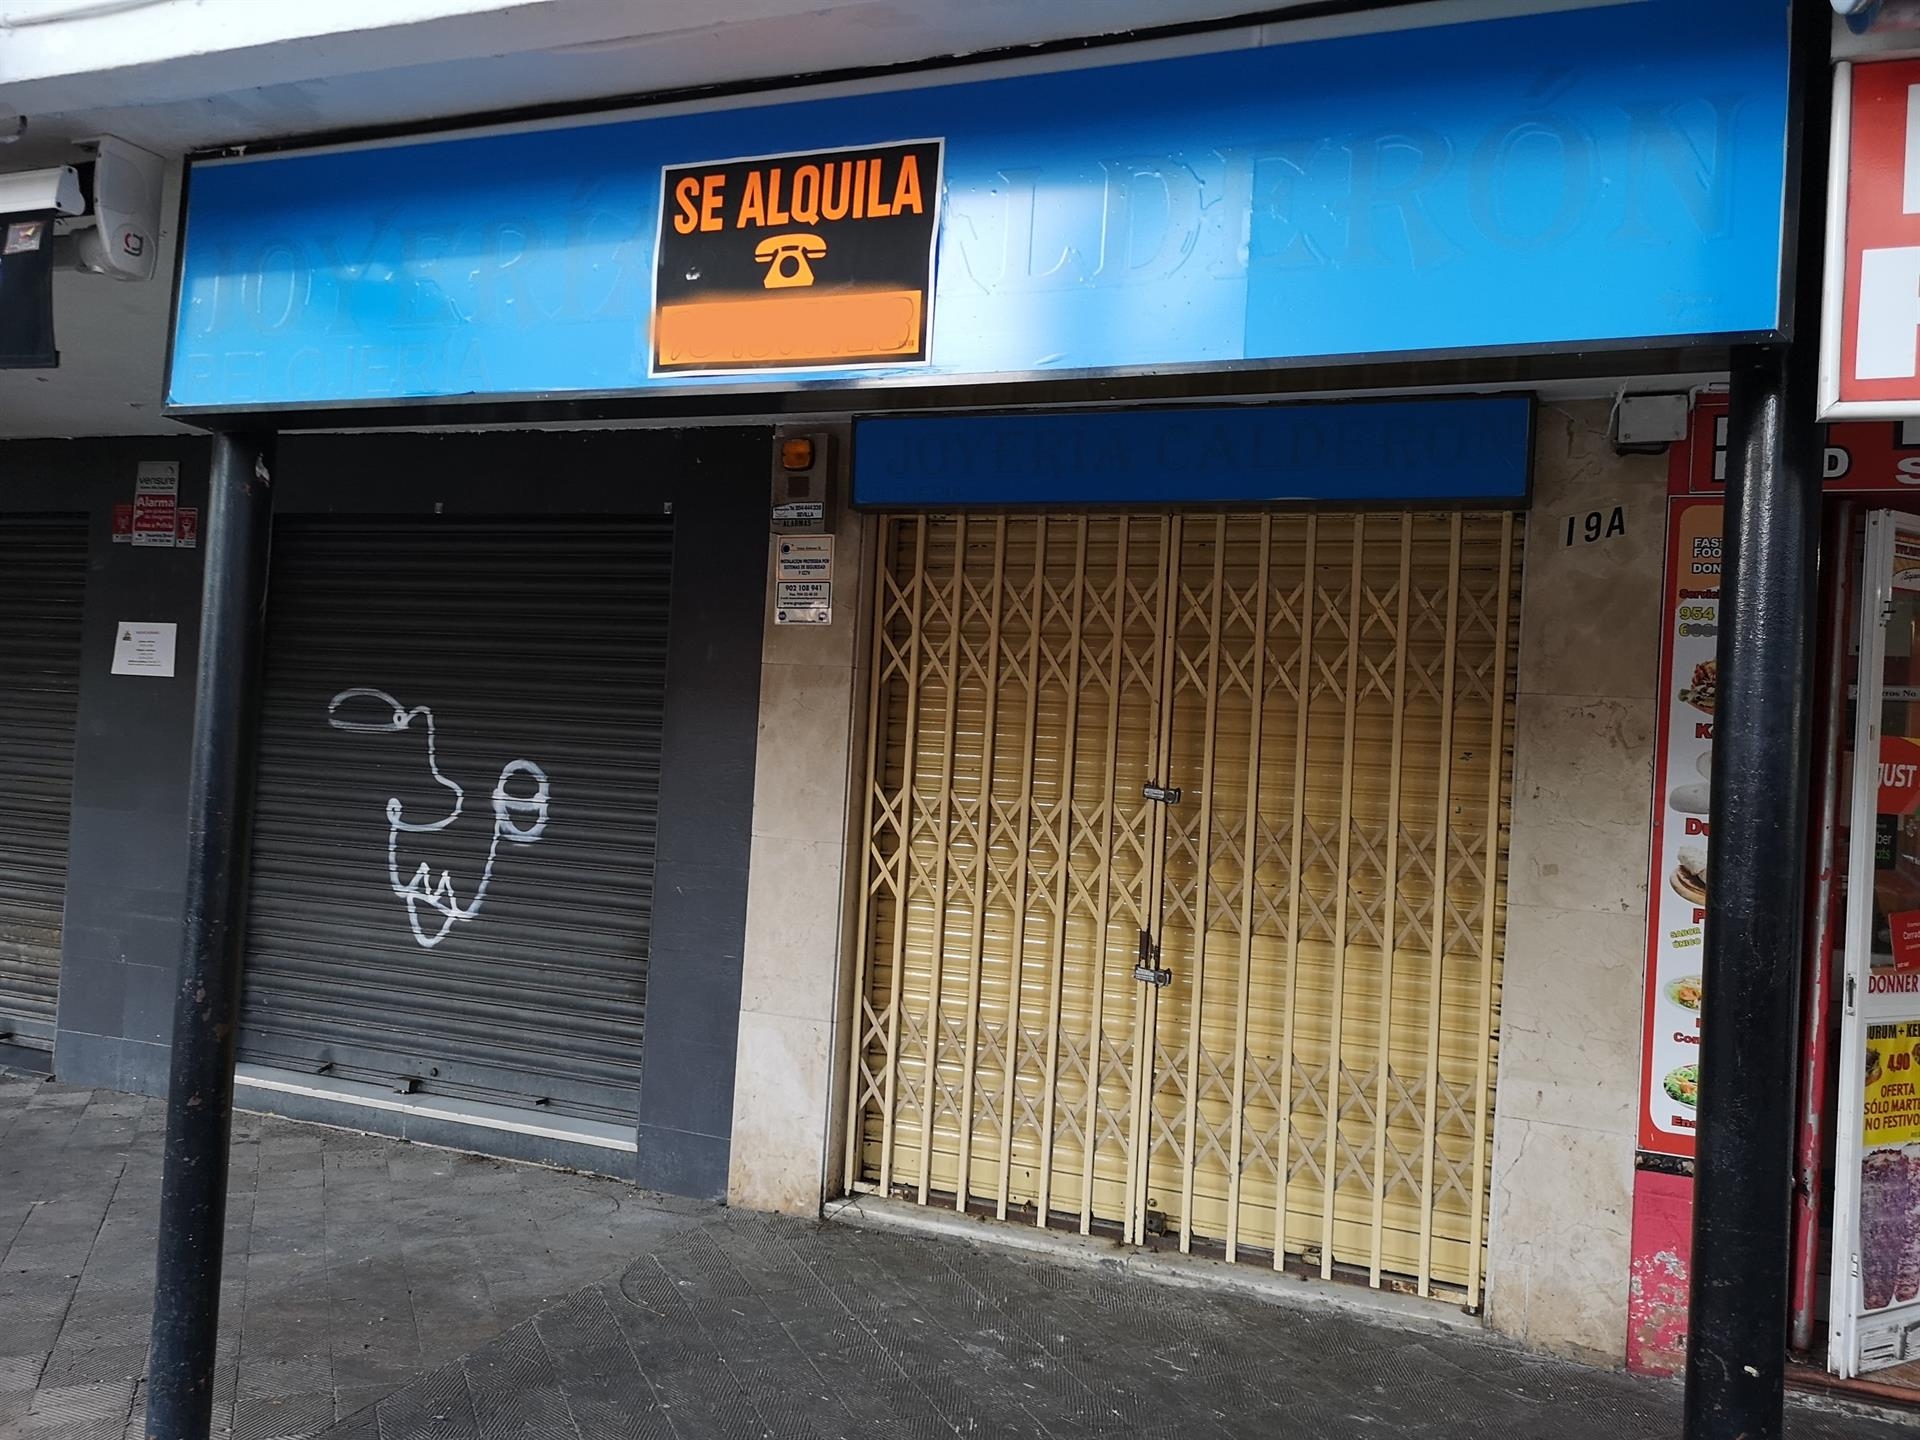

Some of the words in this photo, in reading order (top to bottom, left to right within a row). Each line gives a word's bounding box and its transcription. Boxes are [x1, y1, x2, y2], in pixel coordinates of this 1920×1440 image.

[674, 177, 726, 234] SE
[736, 155, 923, 228] ALQUILA
[136, 496, 174, 507] Alarma
[1567, 506, 1625, 546] 19A
[1679, 606, 1714, 620] 954
[1868, 975, 1919, 993] DONNER
[1880, 1082, 1915, 1098] OFERTA
[1864, 1099, 1889, 1115] SÓLO
[1865, 1117, 1880, 1131] NO
